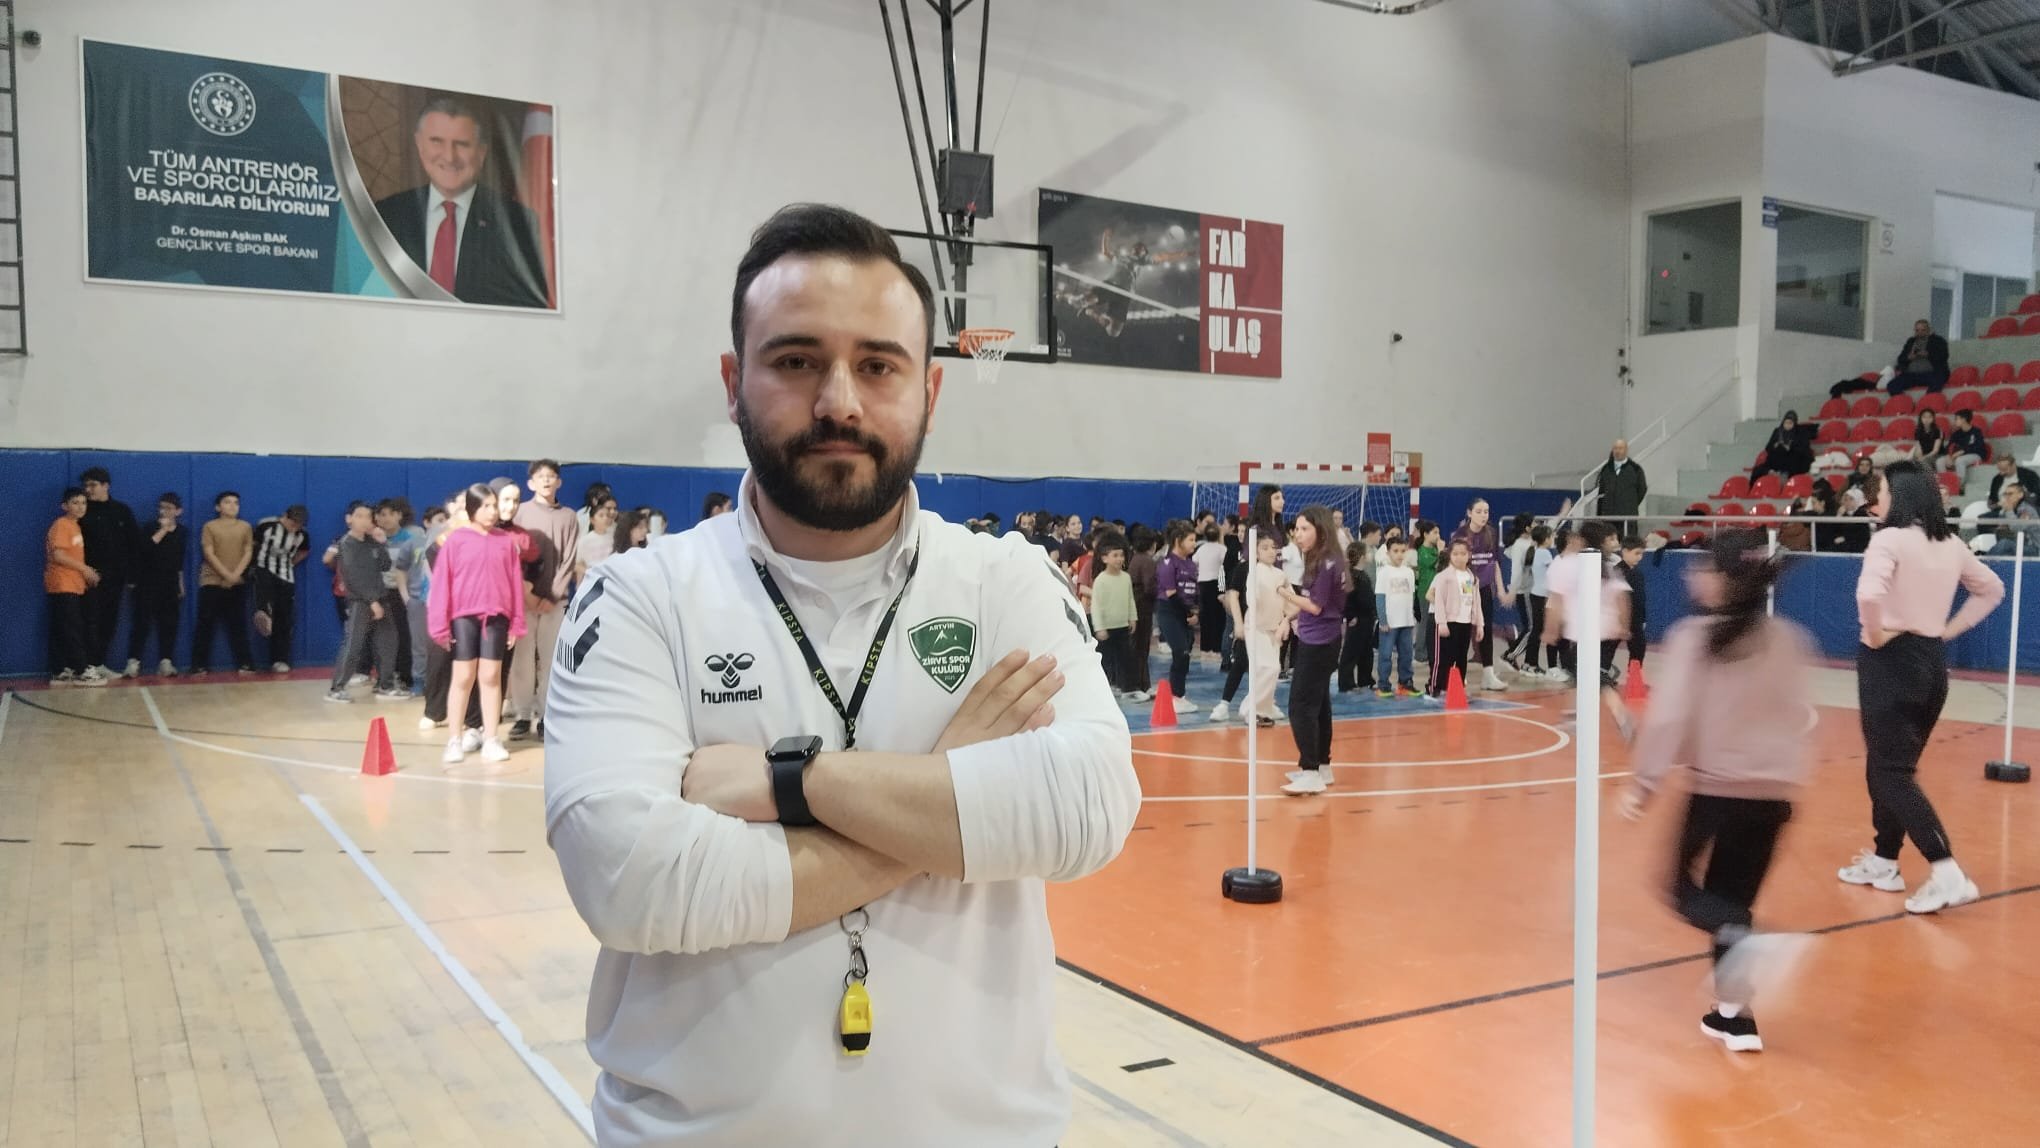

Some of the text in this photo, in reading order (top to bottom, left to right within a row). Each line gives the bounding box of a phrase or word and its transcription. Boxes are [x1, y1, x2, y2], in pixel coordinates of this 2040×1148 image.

[127, 166, 157, 184] VE
[150, 149, 318, 183] TÜM ANTRENÖR
[134, 187, 330, 217] BAŞARILAR DİLİYORUM
[157, 237, 319, 259] GENÇLİK VE SPOR BAKANI
[171, 225, 288, 244] Dr. Osman Aşkın BAK
[1209, 228, 1246, 268] FAR
[1209, 271, 1236, 310] KA
[1209, 315, 1261, 358] ULAŞ
[777, 603, 804, 643] KIPSTA
[861, 639, 885, 685] KIPSTA
[922, 655, 970, 666] ZİRVE SPOR
[931, 664, 965, 675] KULÜBÜ
[701, 684, 762, 704] hummel
[814, 668, 843, 713] KIPSTA
